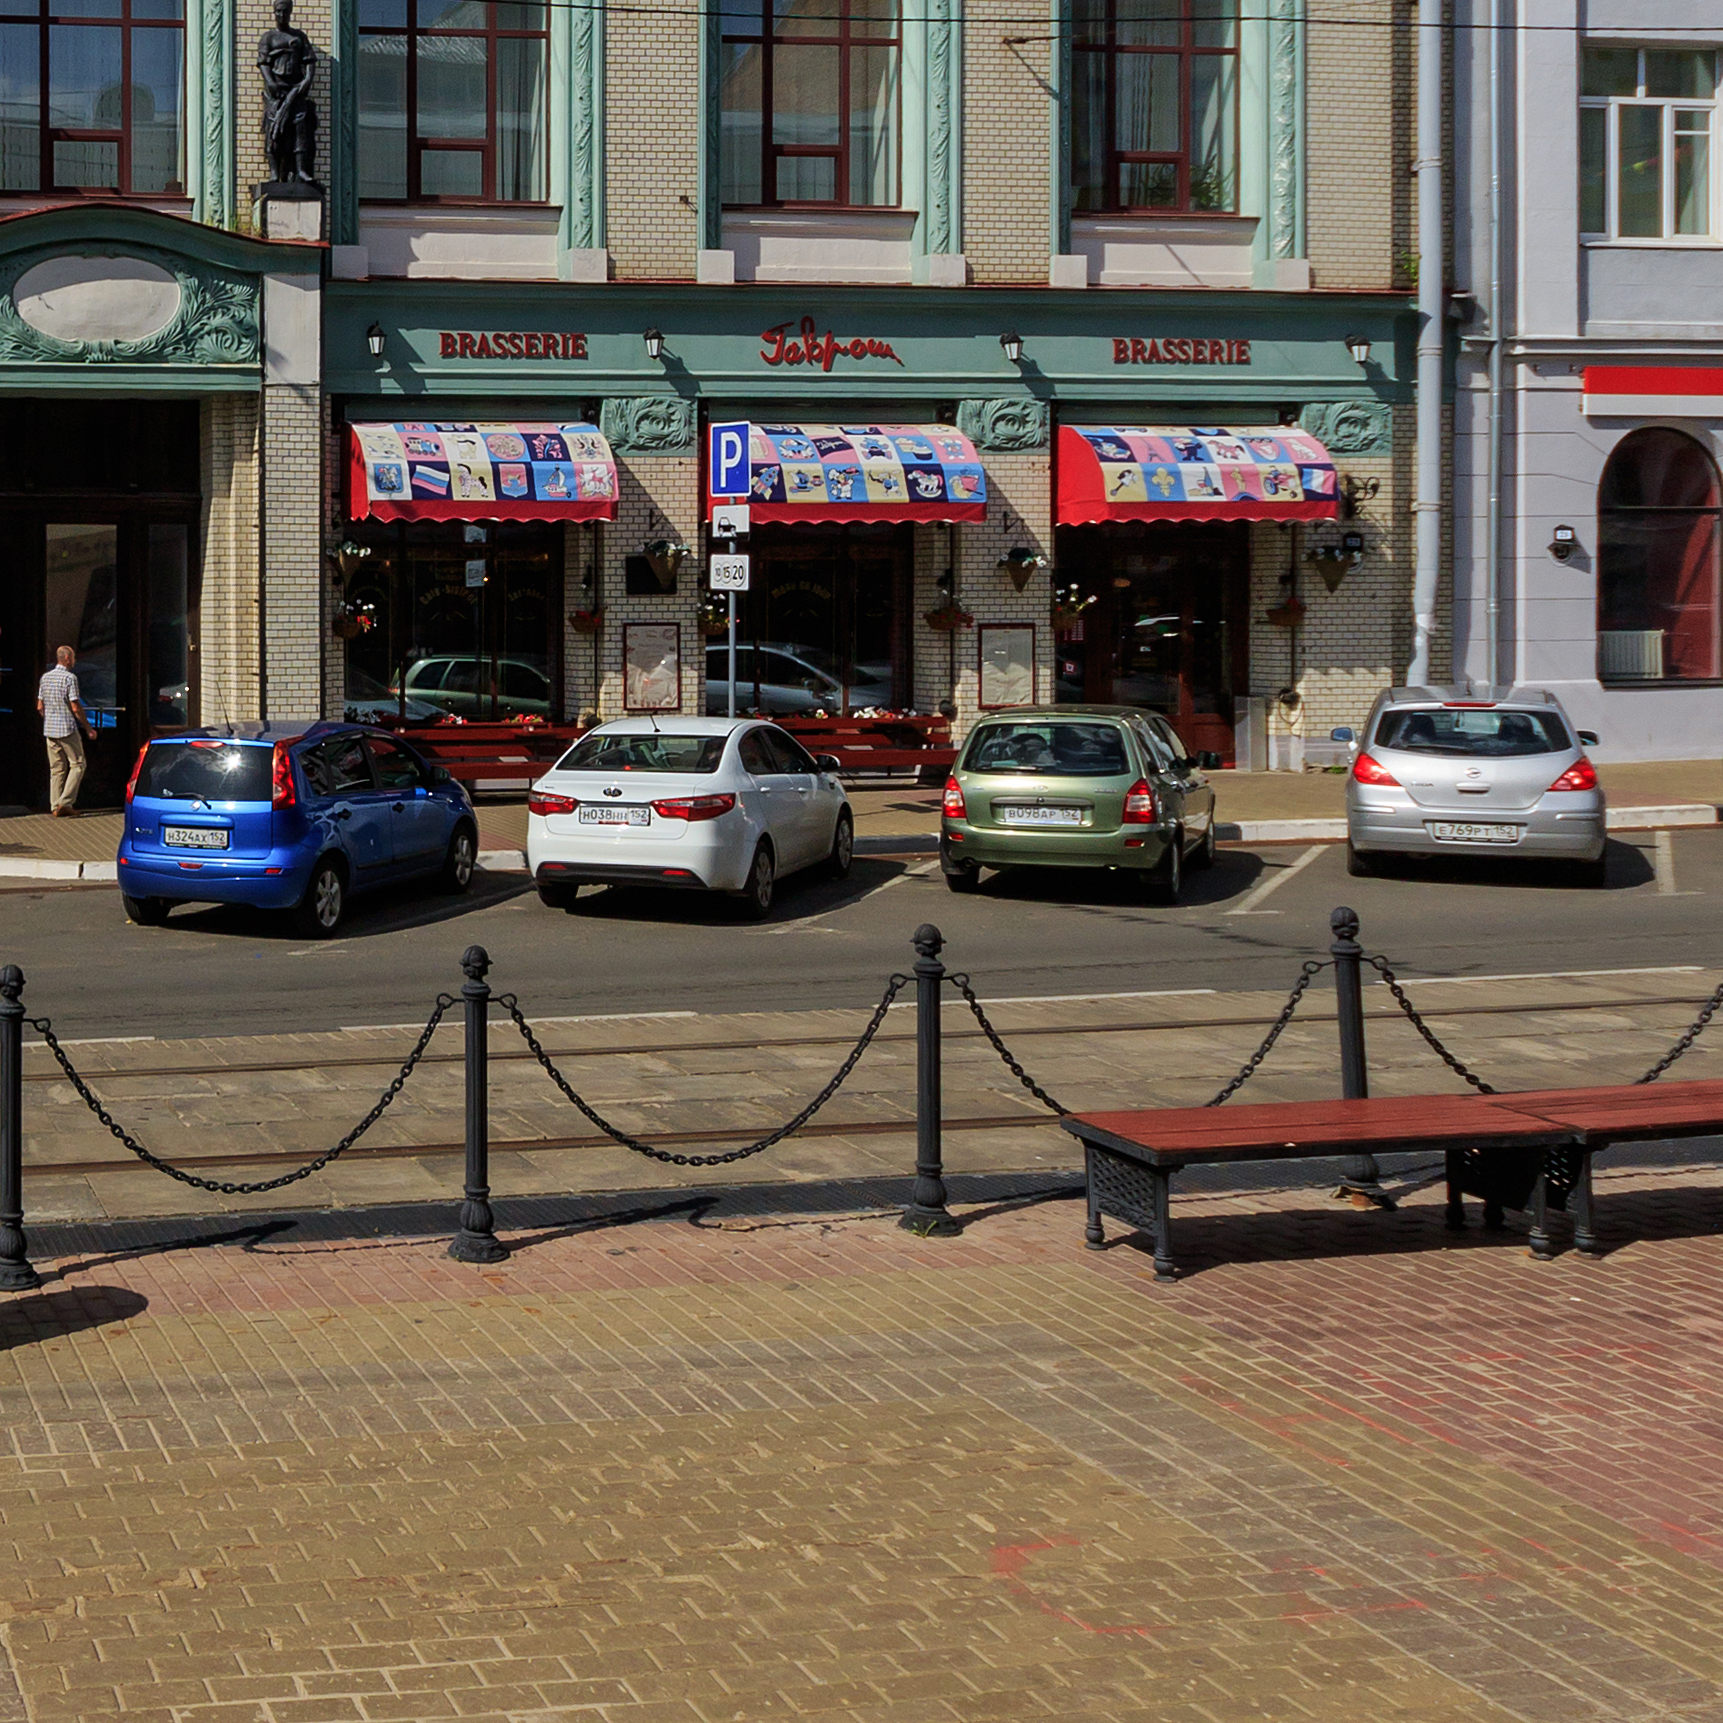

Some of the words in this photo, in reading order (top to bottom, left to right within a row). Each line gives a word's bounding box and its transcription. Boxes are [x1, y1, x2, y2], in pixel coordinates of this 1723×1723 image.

[439, 332, 588, 359] BRASSERIE
[760, 316, 905, 372] Гаврош
[1112, 338, 1252, 364] BRASSERIE
[723, 566, 731, 578] 15
[732, 564, 744, 580] 20
[630, 810, 648, 819] 152
[1060, 809, 1078, 818] 152
[1494, 826, 1514, 834] 152
[209, 832, 225, 842] 152
